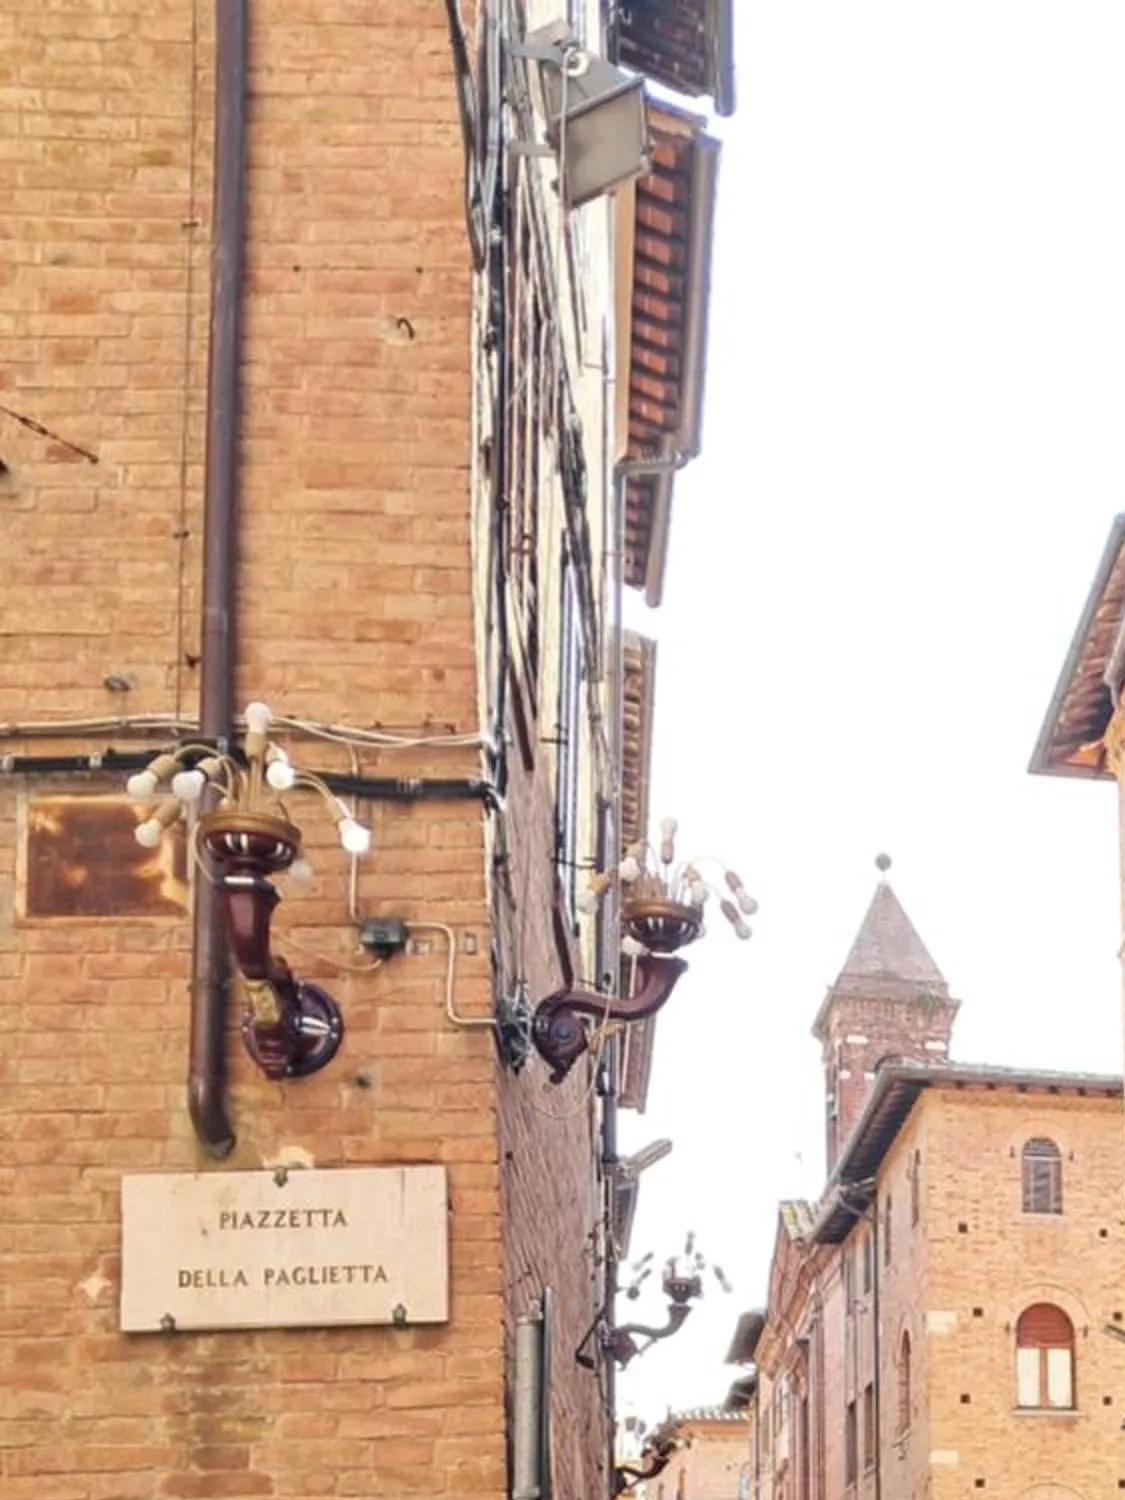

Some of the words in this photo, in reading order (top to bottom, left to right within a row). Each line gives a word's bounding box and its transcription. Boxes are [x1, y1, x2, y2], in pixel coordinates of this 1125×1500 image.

[219, 1208, 349, 1230] PIAZZETTA
[177, 1269, 249, 1288] DELLA
[263, 1264, 389, 1286] PAGLIETTA
